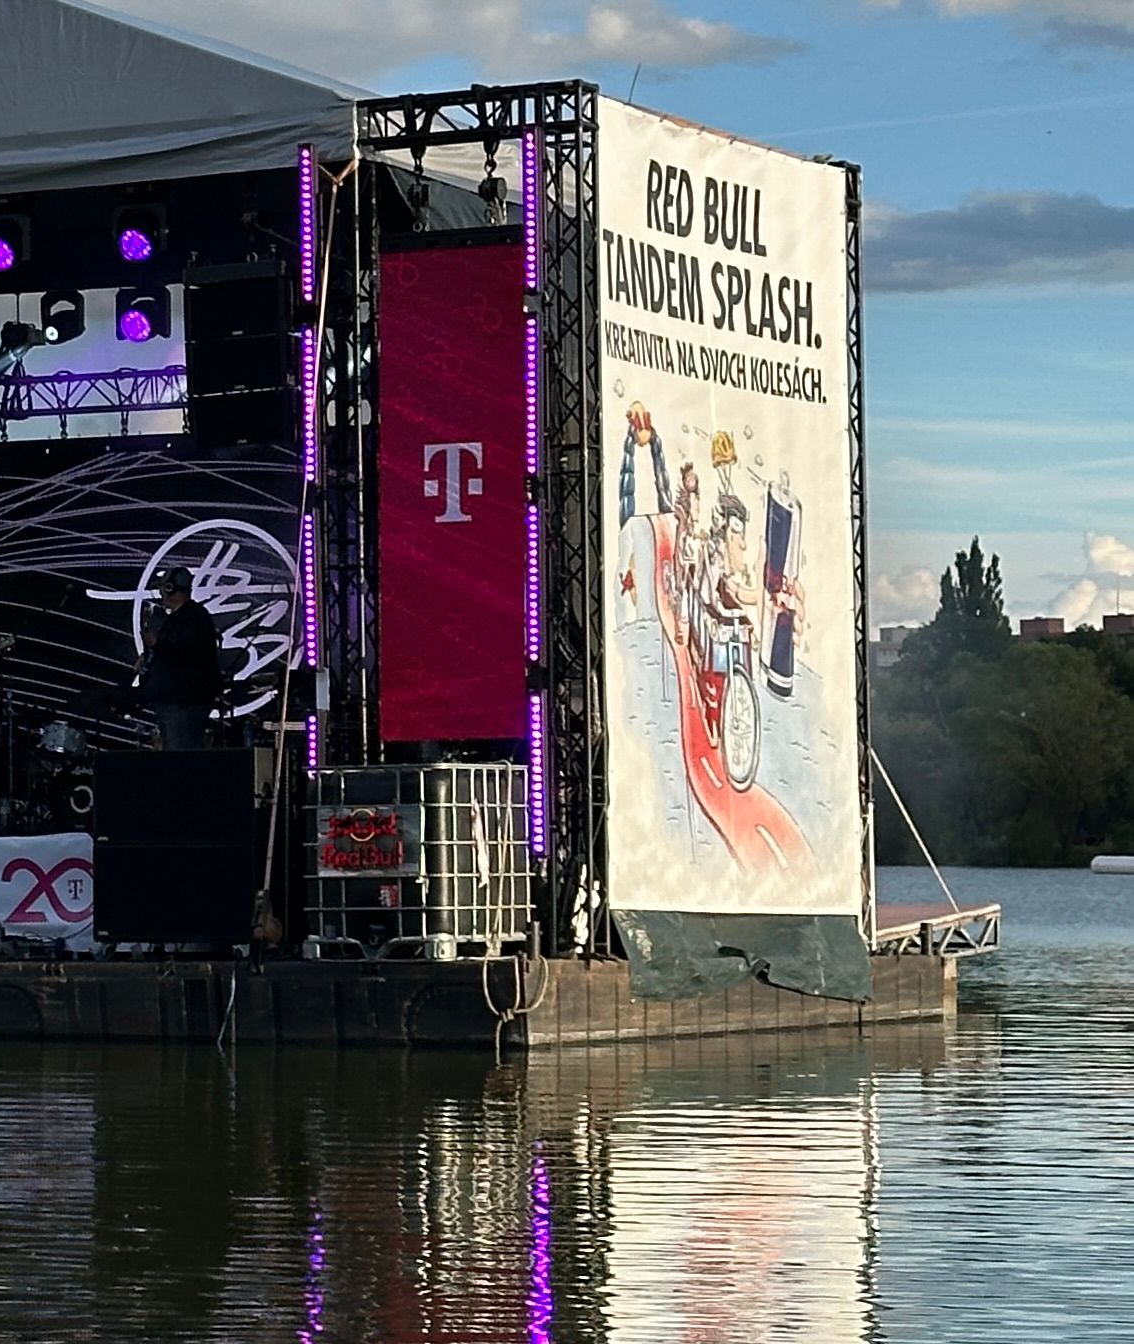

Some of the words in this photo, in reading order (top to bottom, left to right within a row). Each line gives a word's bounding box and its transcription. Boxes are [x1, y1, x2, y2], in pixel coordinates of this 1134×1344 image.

[646, 159, 694, 239] RED
[704, 176, 767, 257] BULL
[603, 229, 704, 325] TANDEM
[711, 261, 823, 350] SPLASH.
[604, 320, 674, 374] KREATIVITA
[678, 341, 698, 380] NA
[700, 347, 746, 390] DVOCH
[750, 356, 827, 404] KOLESÁCH.
[423, 442, 483, 523] T
[1, 857, 94, 923] 20
